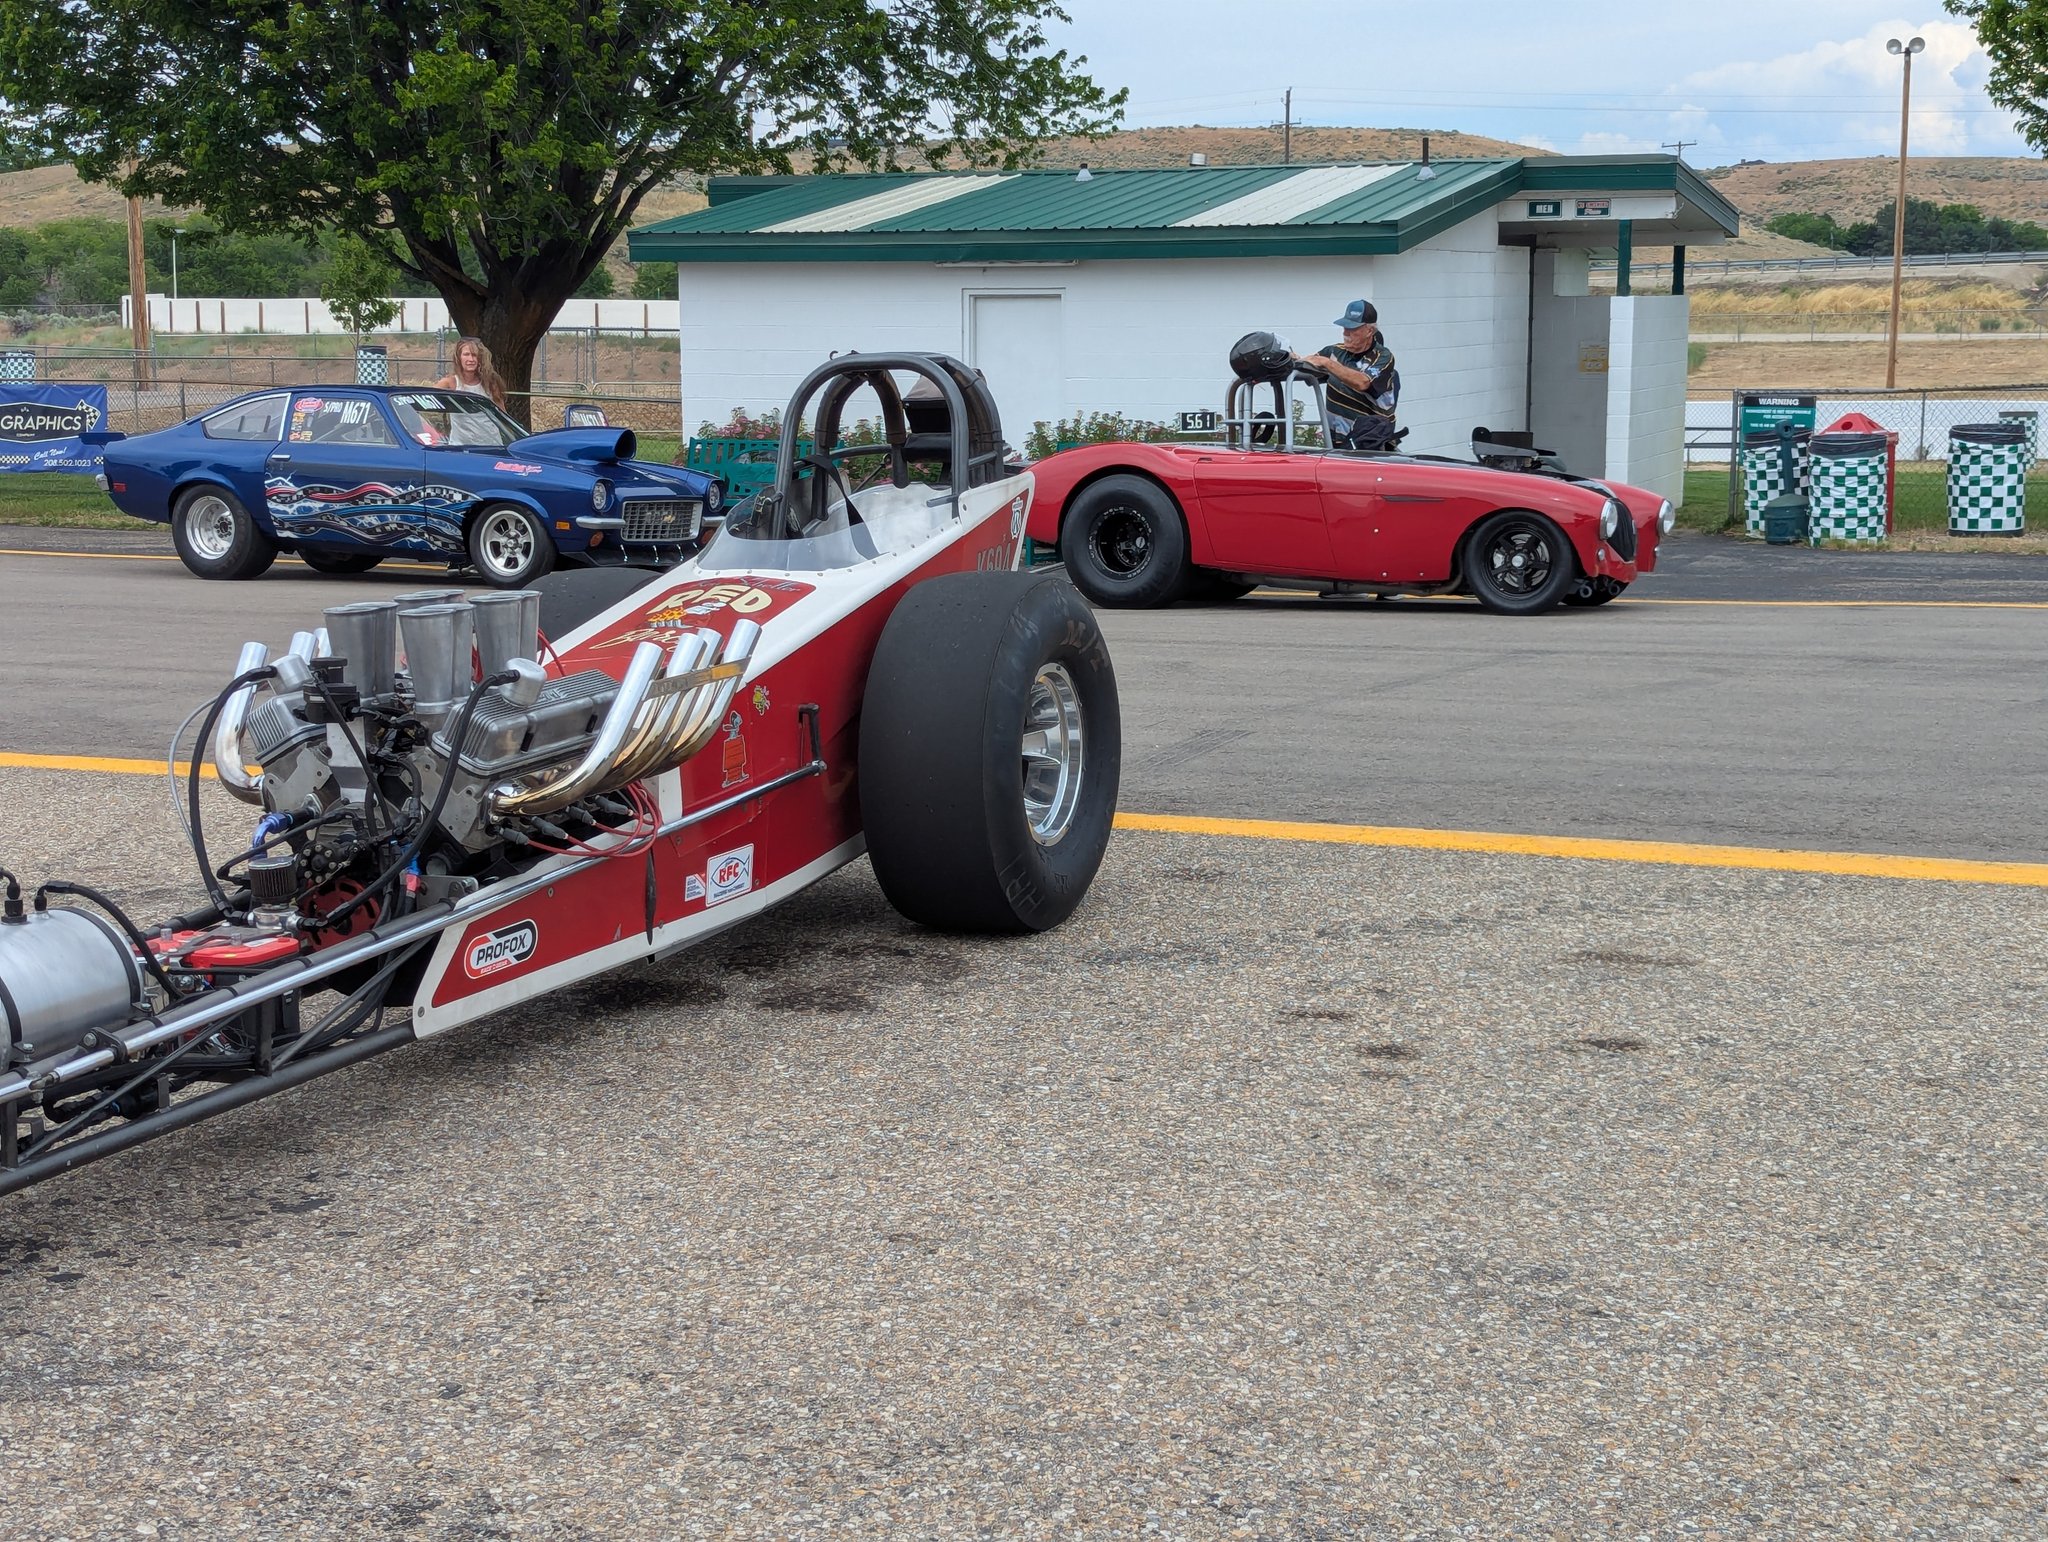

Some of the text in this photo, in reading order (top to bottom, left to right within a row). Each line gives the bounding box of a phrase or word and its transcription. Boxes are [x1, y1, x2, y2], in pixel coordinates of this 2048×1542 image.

[1535, 204, 1554, 214] MEN
[411, 394, 446, 410] M671
[1758, 398, 1800, 406] WARNING
[340, 401, 371, 424] M671
[0, 415, 82, 431] GRAPHICS
[34, 451, 49, 461] Call
[645, 584, 773, 614] RED
[718, 861, 741, 884] RFC
[475, 933, 527, 966] PROFOX
